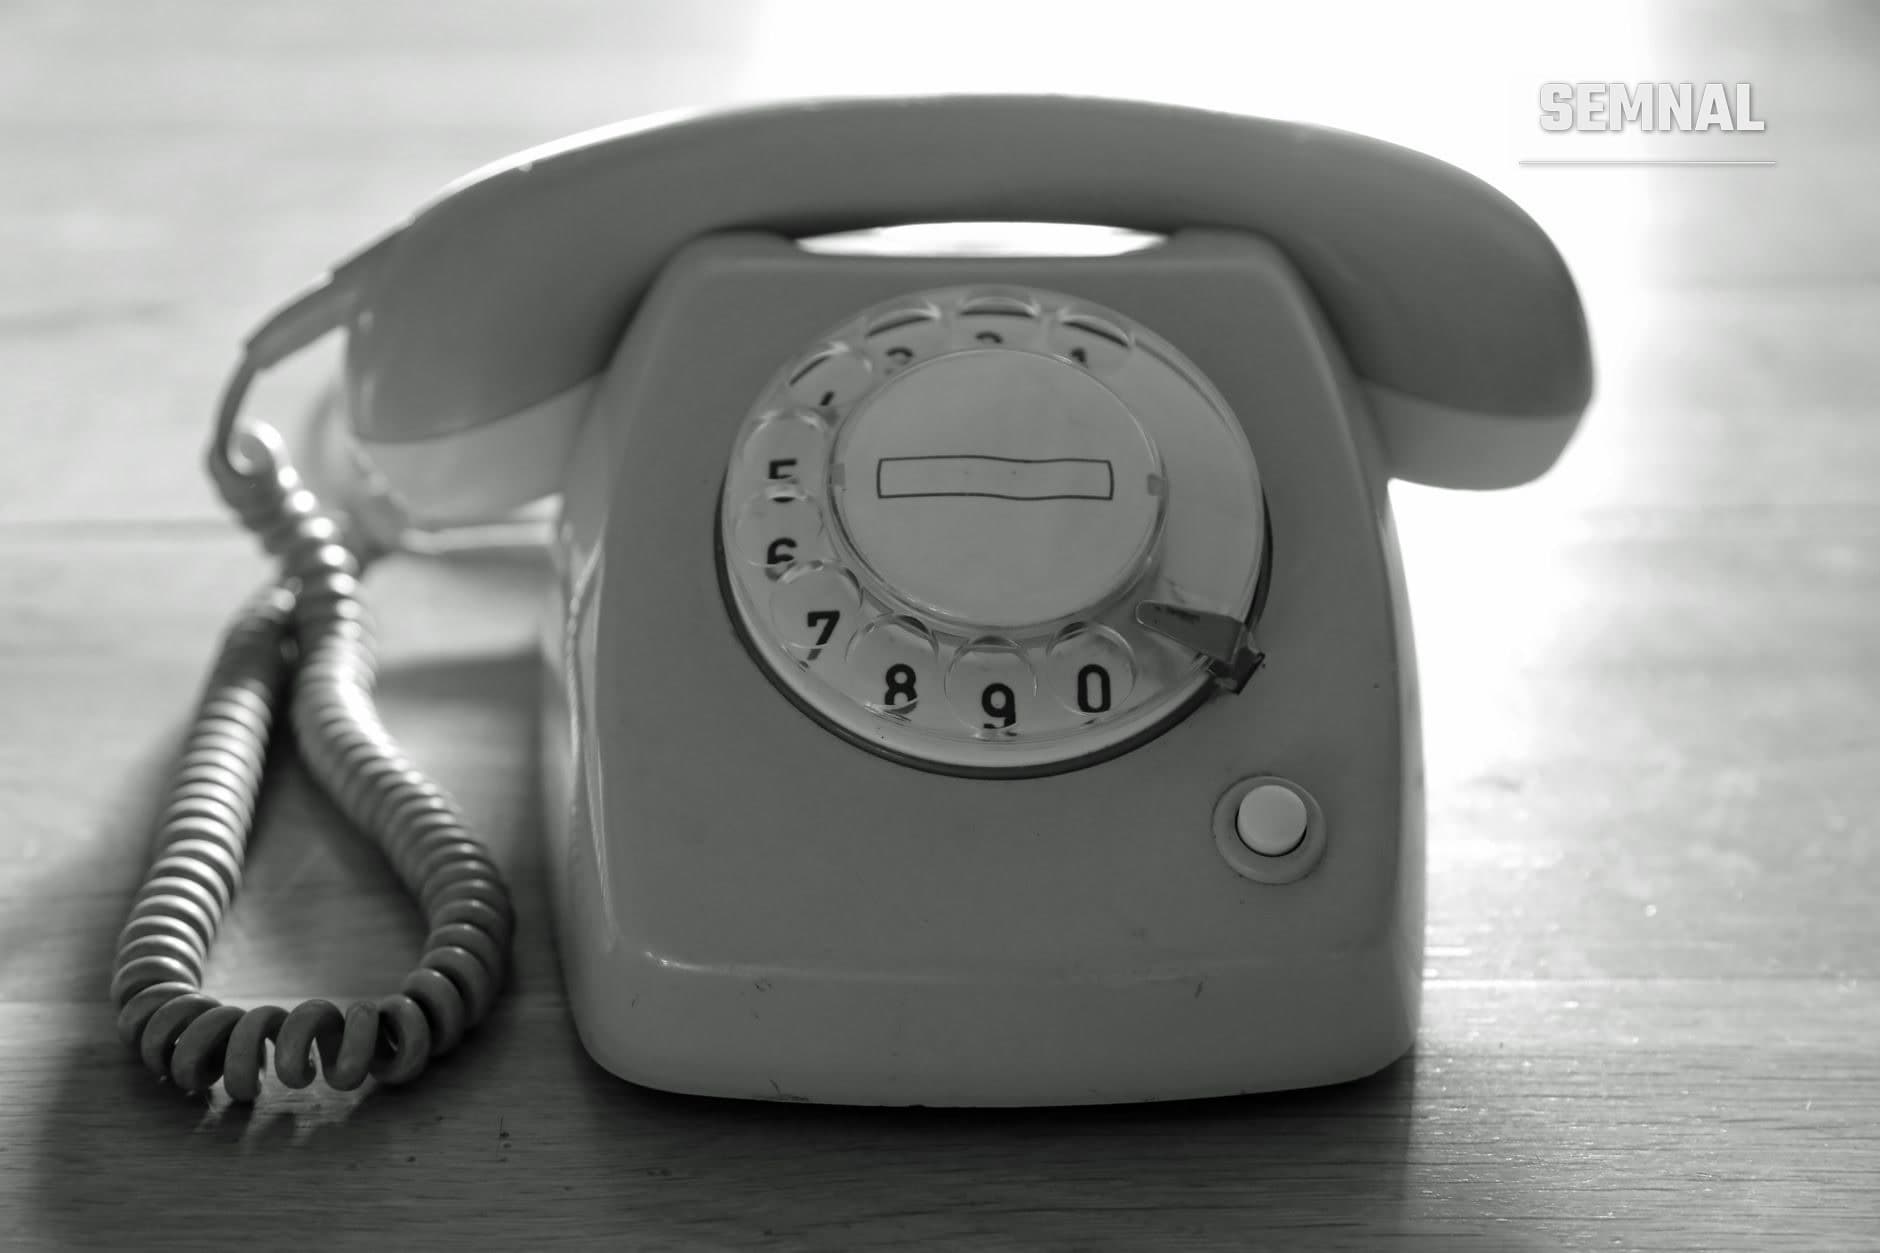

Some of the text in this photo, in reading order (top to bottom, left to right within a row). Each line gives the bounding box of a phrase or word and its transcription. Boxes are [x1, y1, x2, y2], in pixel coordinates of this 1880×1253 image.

[766, 537, 797, 581] 6
[807, 610, 840, 660] 7
[884, 663, 917, 714] 8
[981, 683, 1017, 730] 9
[1077, 664, 1111, 713] 0
